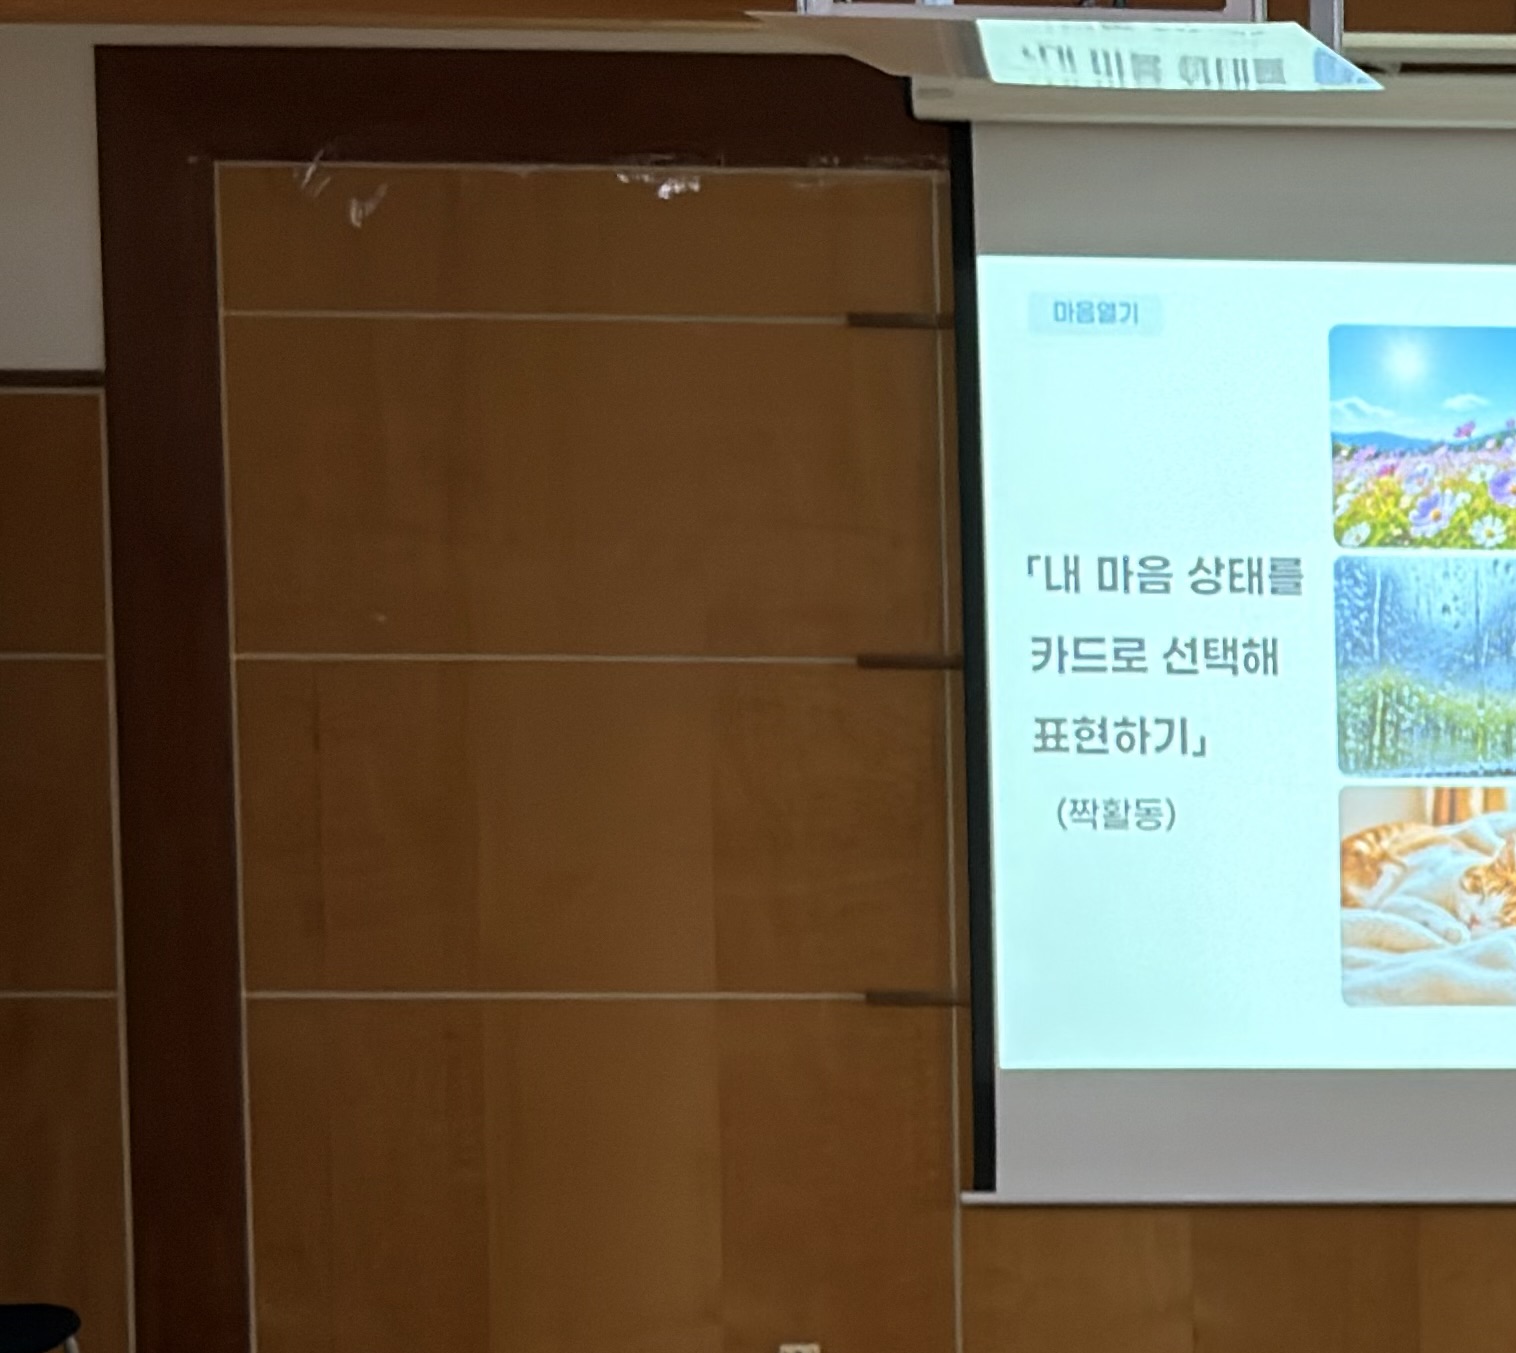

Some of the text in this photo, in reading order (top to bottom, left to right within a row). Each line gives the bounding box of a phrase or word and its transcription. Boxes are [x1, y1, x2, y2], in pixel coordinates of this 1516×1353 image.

[1053, 300, 1139, 325] 마음열기
[1098, 555, 1173, 595] 마음
[1188, 556, 1304, 596] 상태를
[1030, 635, 1279, 676] 카드로 선택해
[1033, 715, 1207, 757] 표현하기」
[1057, 796, 1176, 832] (짝활동)
